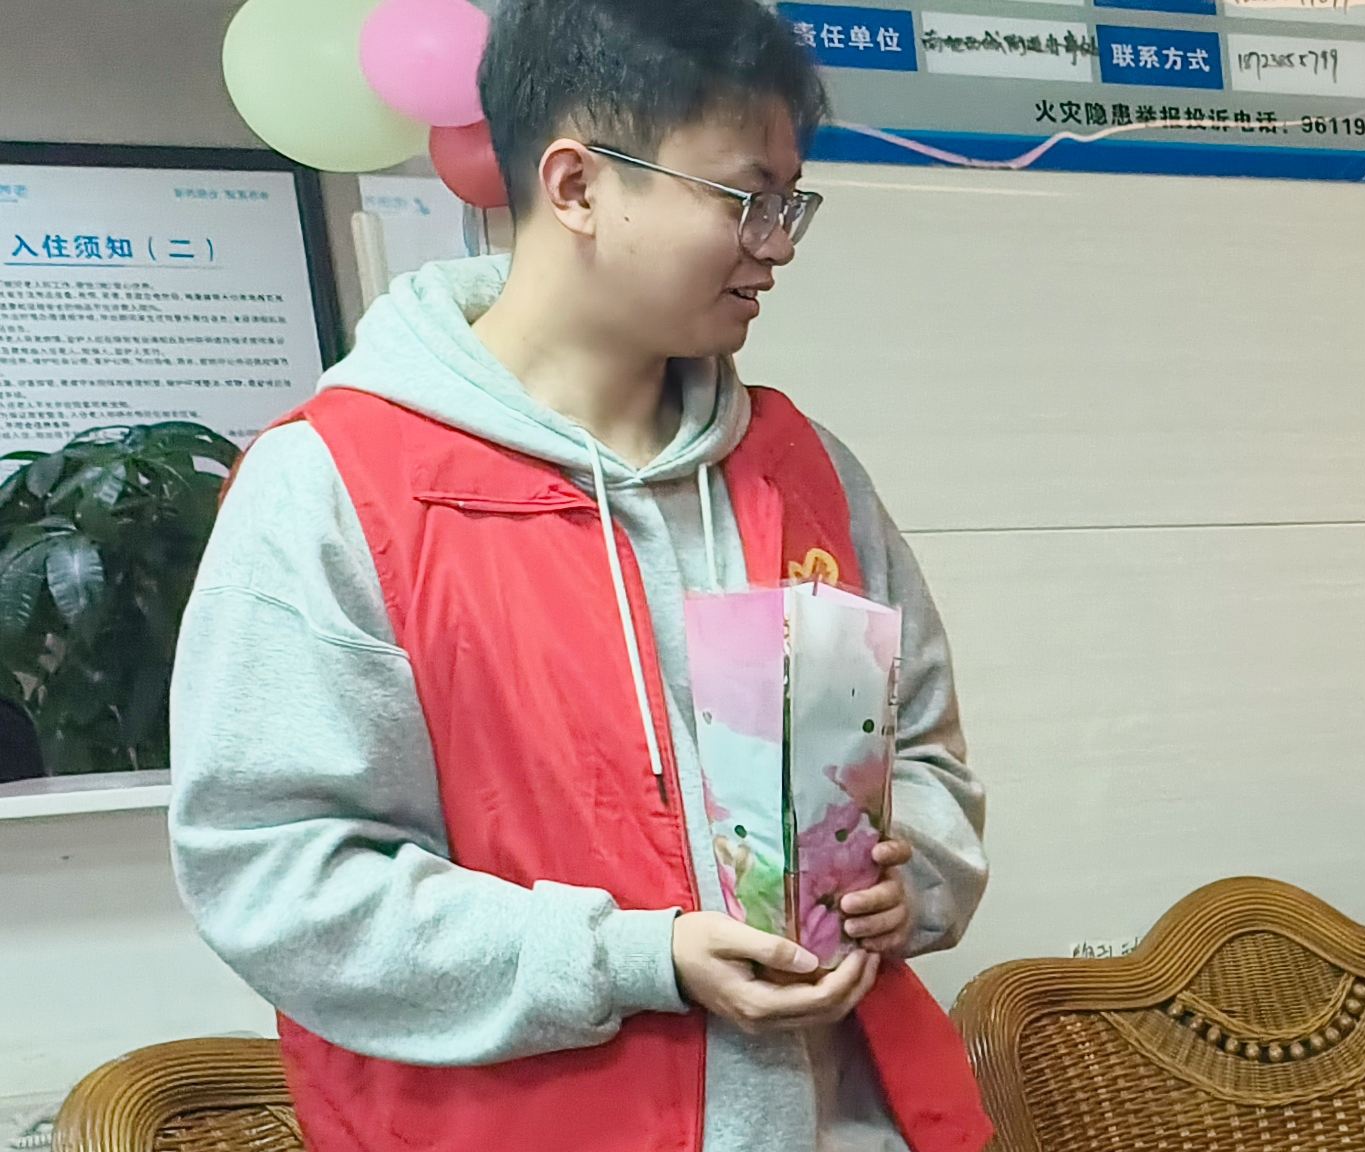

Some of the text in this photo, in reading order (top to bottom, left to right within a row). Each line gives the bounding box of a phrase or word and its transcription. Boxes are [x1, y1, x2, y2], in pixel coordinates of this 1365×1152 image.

[792, 22, 902, 52] 责任单位
[1110, 43, 1211, 73] 联系方式
[11, 233, 215, 262] 入住须知（二）
